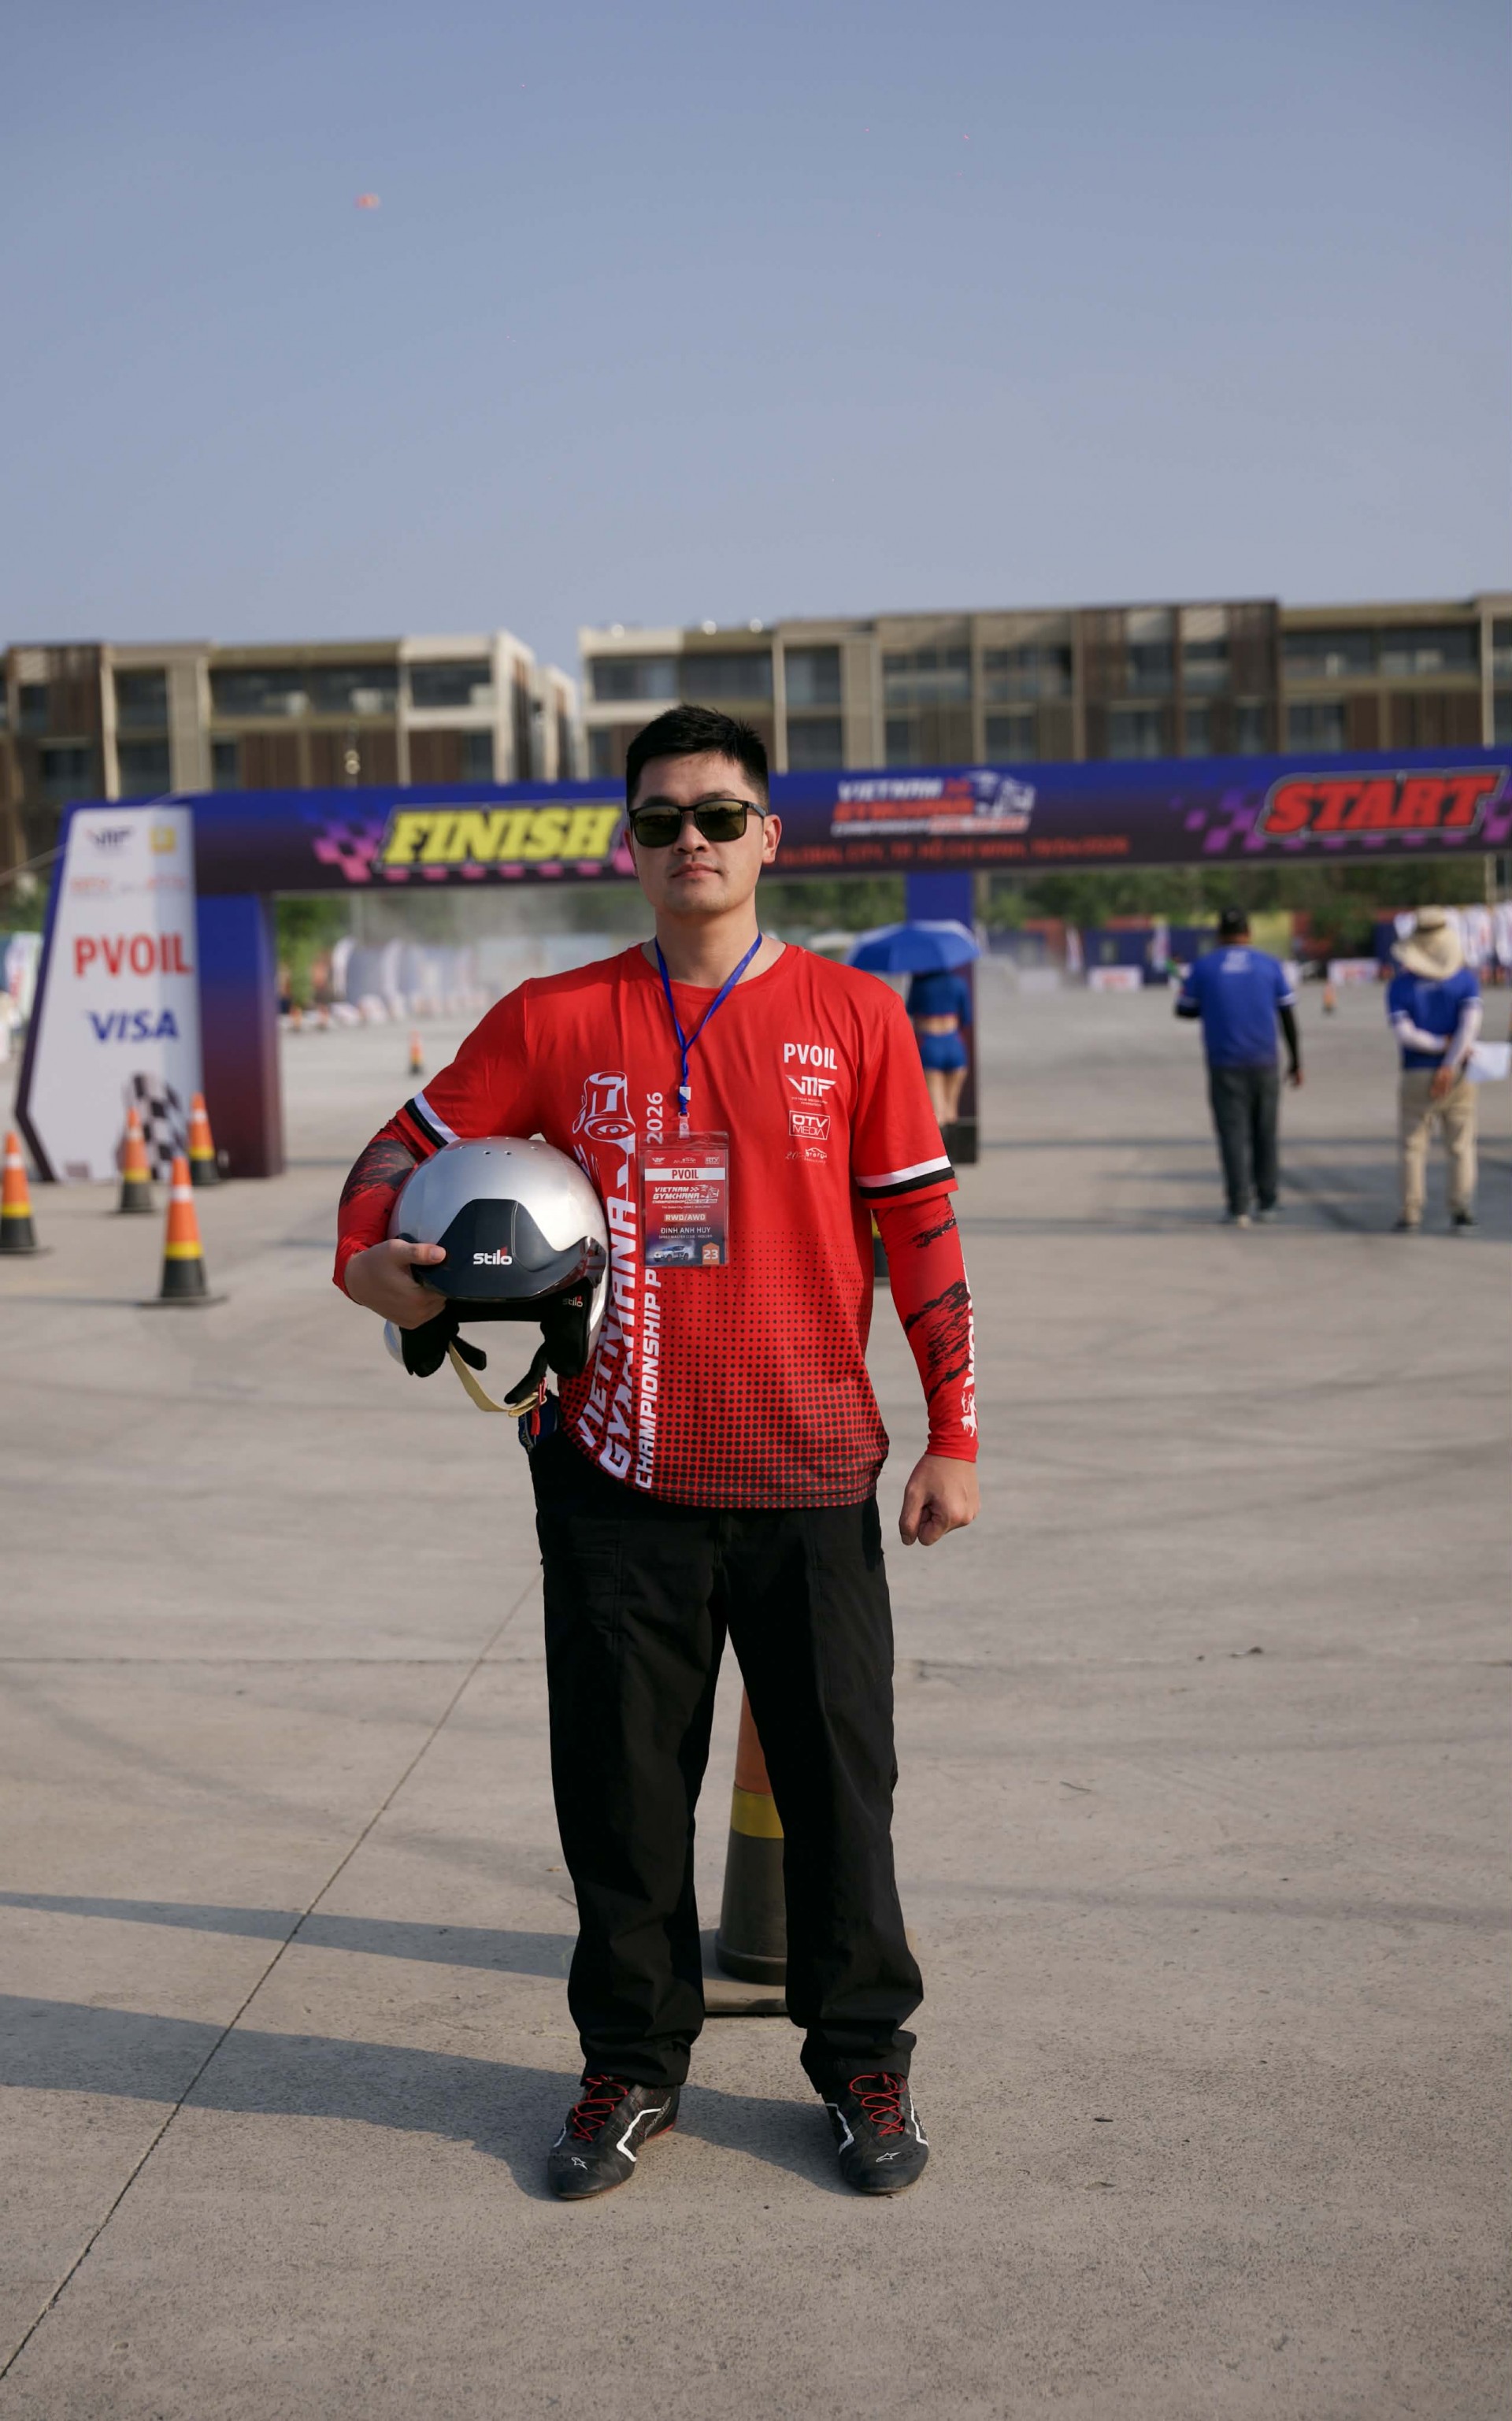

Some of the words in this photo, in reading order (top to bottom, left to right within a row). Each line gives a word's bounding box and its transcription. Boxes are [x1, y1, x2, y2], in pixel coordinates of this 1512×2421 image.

[1264, 774, 1499, 834] START
[384, 805, 623, 865] FINISH
[74, 933, 195, 978] PVOIL
[88, 1009, 178, 1043] VISA
[784, 1043, 838, 1070] PVOIL
[647, 1092, 663, 1144] 2026
[792, 1114, 828, 1128] OTV
[792, 1124, 825, 1140] MEDIA
[672, 1170, 699, 1179] PVOIL
[473, 1248, 512, 1266] Stilo
[703, 1249, 718, 1259] 23
[562, 1296, 584, 1307] Stilo
[635, 1292, 662, 1489] CHAMPIONSHIP
